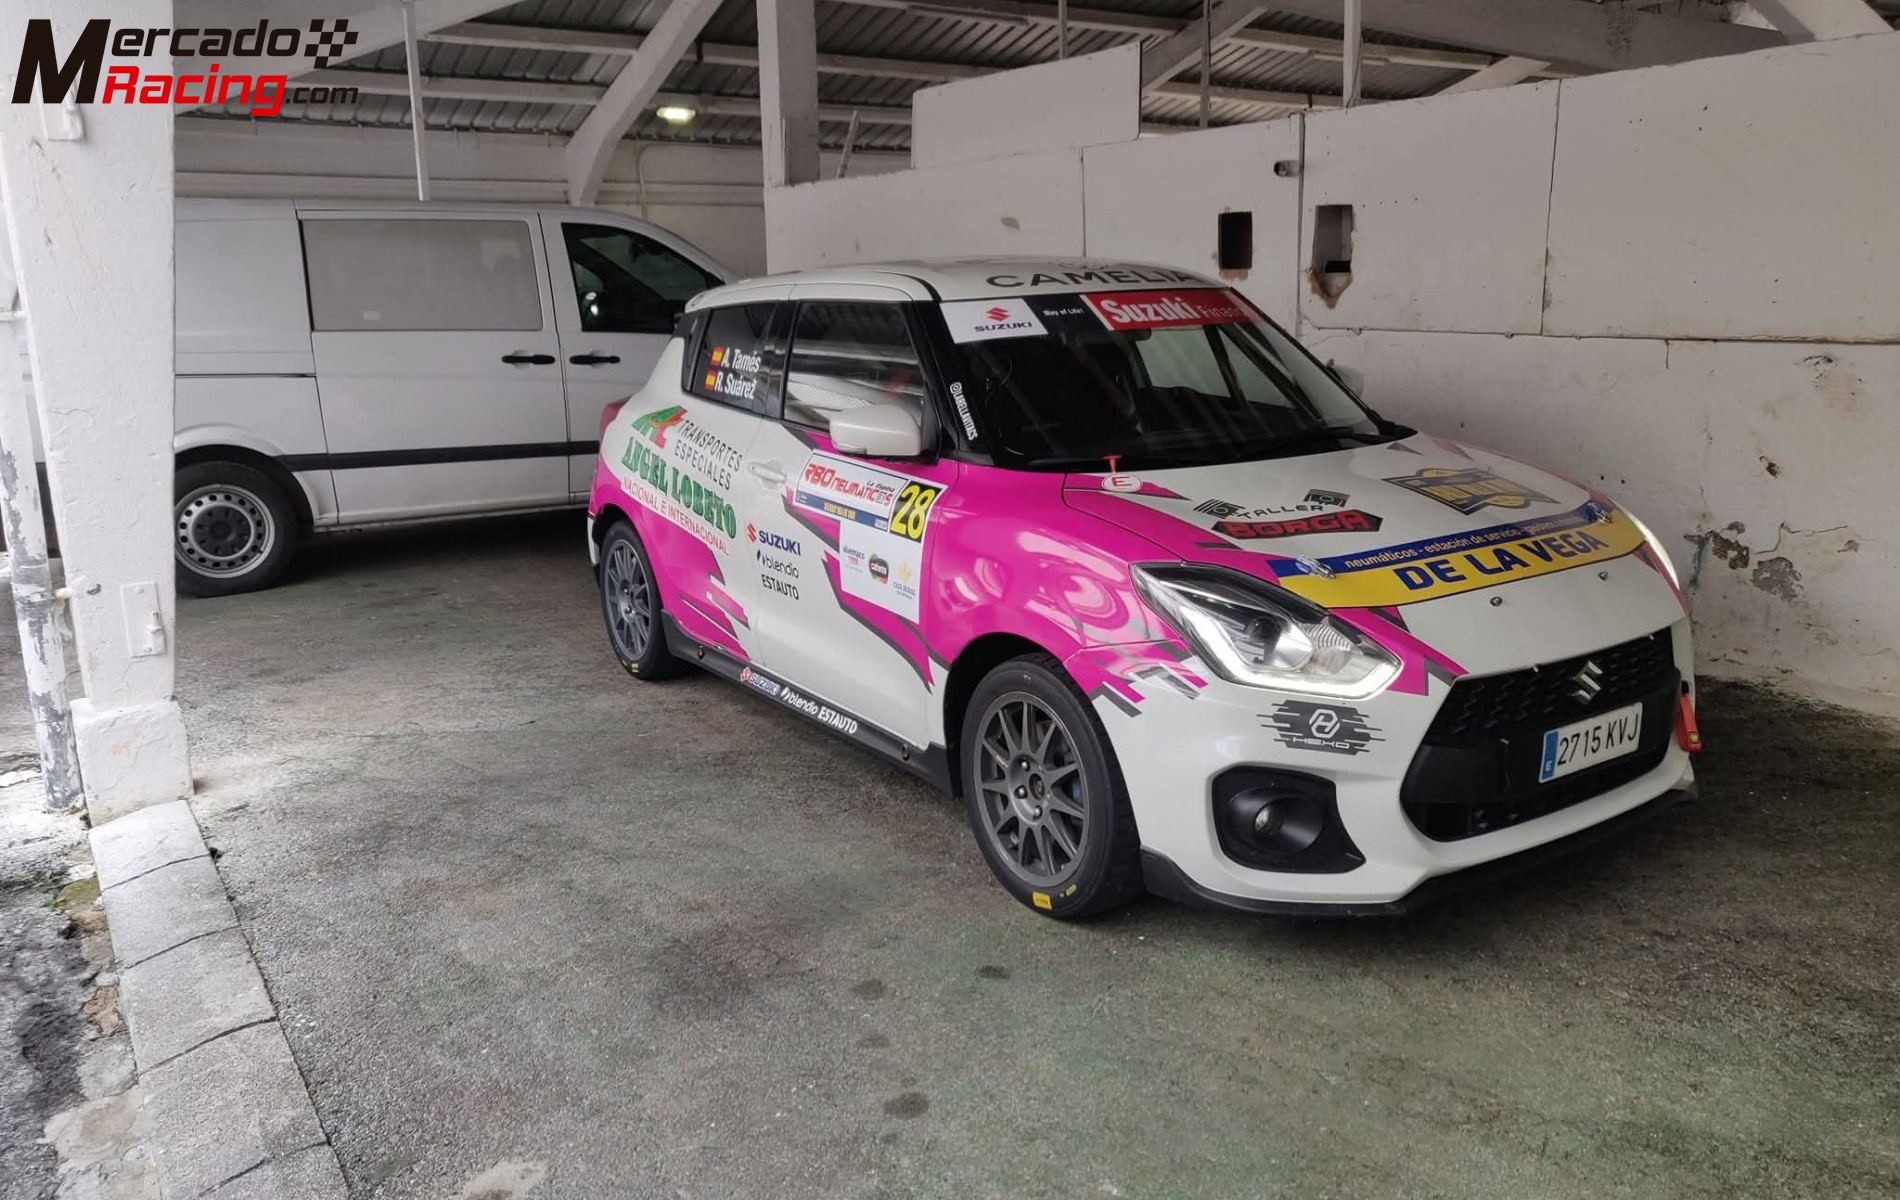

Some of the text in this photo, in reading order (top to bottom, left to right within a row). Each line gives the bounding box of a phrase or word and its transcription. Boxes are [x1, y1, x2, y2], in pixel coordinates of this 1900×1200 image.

[985, 269, 1217, 288] CAMELIA
[1100, 297, 1201, 323] Suzuki
[974, 321, 1033, 333] SUZUKI
[721, 347, 762, 373] A. Tamés
[714, 371, 757, 399] R. Suárez
[678, 420, 743, 473] TRANSPORTES
[674, 439, 732, 491] ESPECIALES
[621, 435, 737, 540] ANGEL LOBETO
[1110, 476, 1133, 487] E
[622, 476, 730, 557] NACIONAL E INTERNACIONAL
[889, 484, 926, 540] 28
[1222, 509, 1371, 538] BORGA
[1237, 503, 1325, 520] TALLER
[758, 530, 802, 557] SUZUKI
[1344, 526, 1522, 569] neumáticos estación de servicio
[1393, 531, 1609, 592] DE LA VEGA
[761, 573, 800, 600] ESTAUTO
[818, 705, 858, 734] ESTAUTO
[1557, 725, 1602, 766] 2715
[1606, 713, 1639, 750] KVJ
